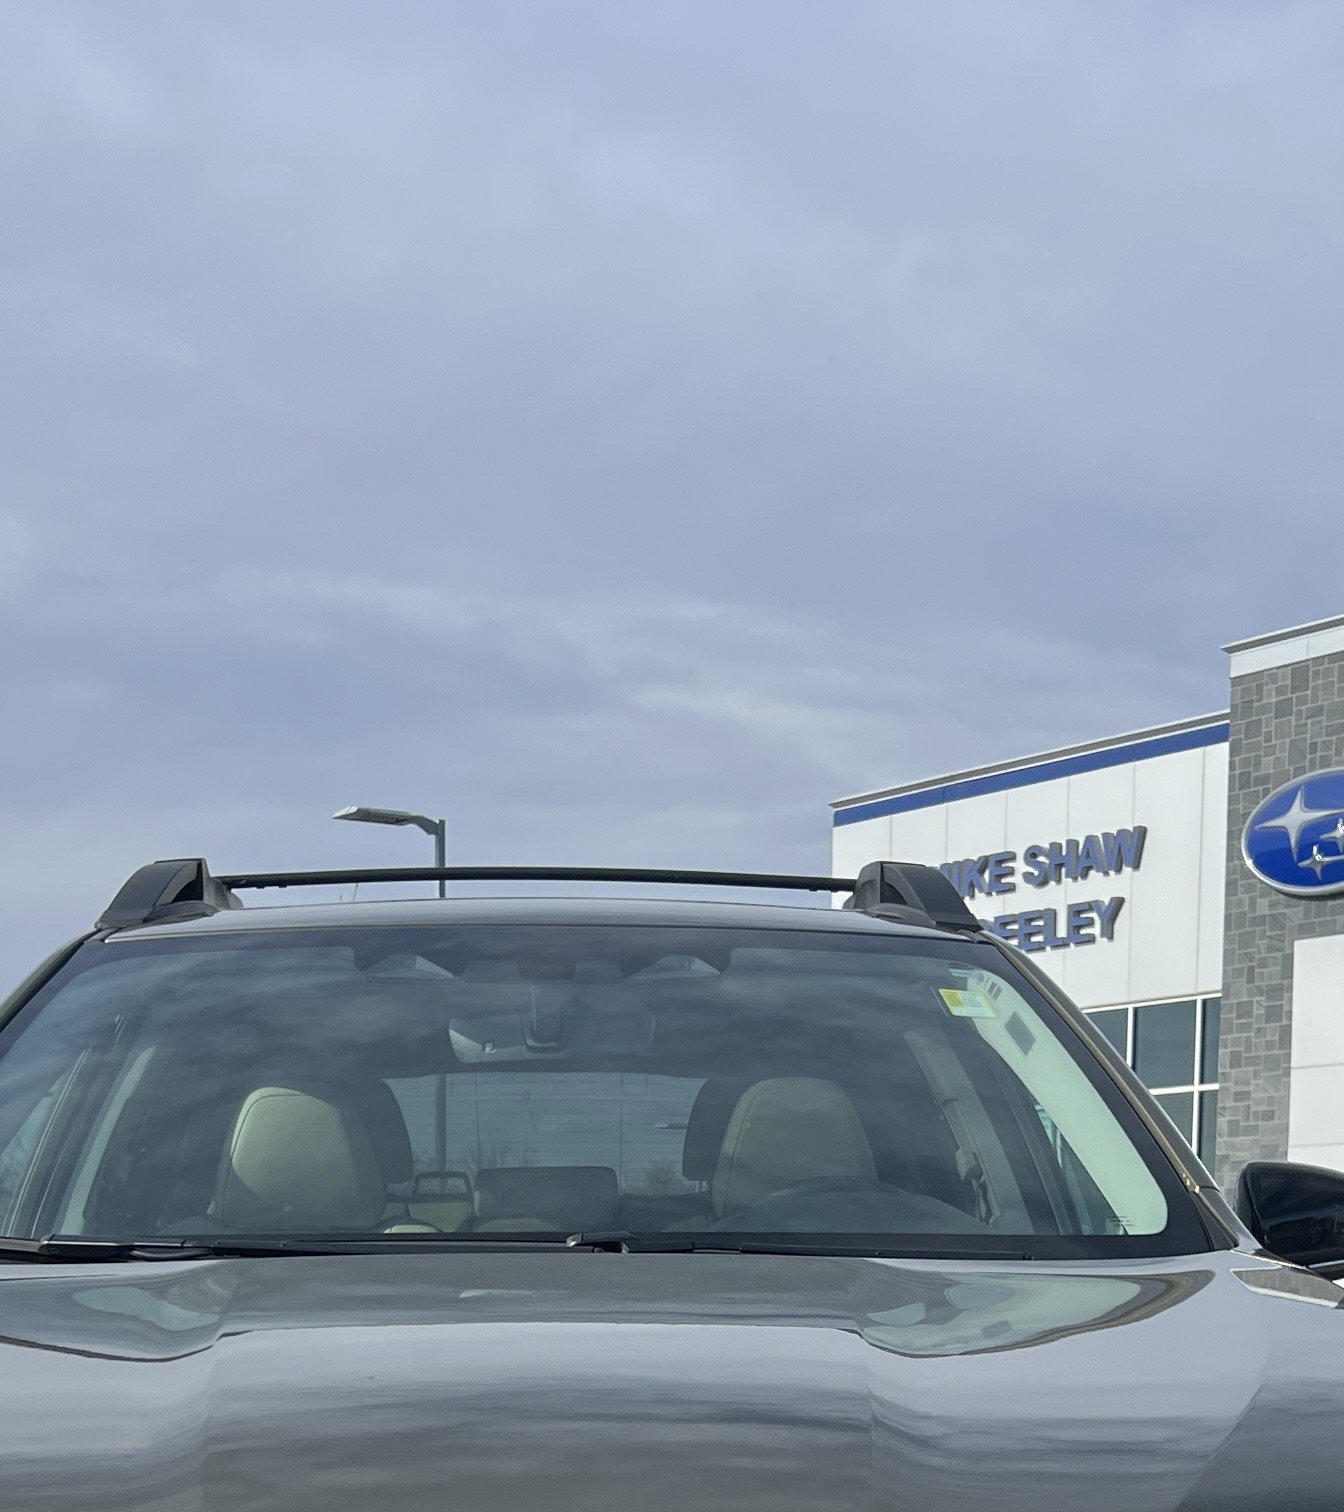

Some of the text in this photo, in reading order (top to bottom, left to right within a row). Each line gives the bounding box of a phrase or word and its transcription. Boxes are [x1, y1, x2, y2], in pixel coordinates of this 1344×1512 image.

[939, 824, 1147, 901] IKE SHAW
[977, 896, 1125, 954] EELEY
